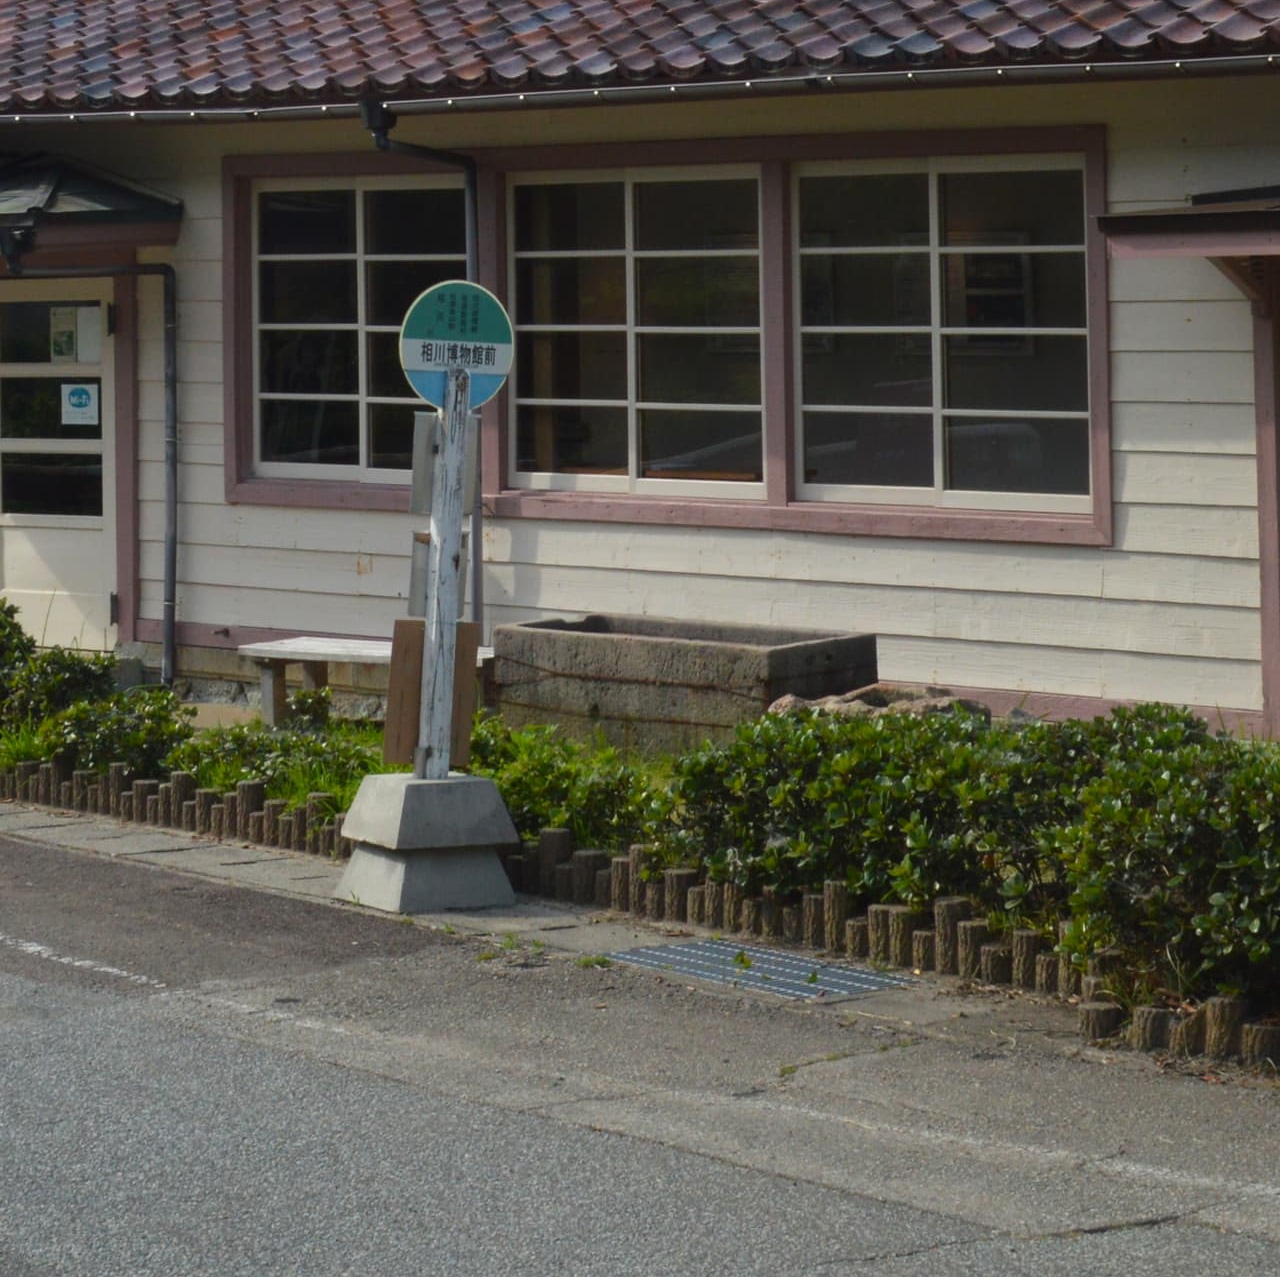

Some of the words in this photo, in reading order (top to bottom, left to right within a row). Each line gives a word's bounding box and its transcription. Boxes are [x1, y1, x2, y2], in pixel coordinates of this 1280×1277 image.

[421, 342, 496, 366] 相川博物館前
